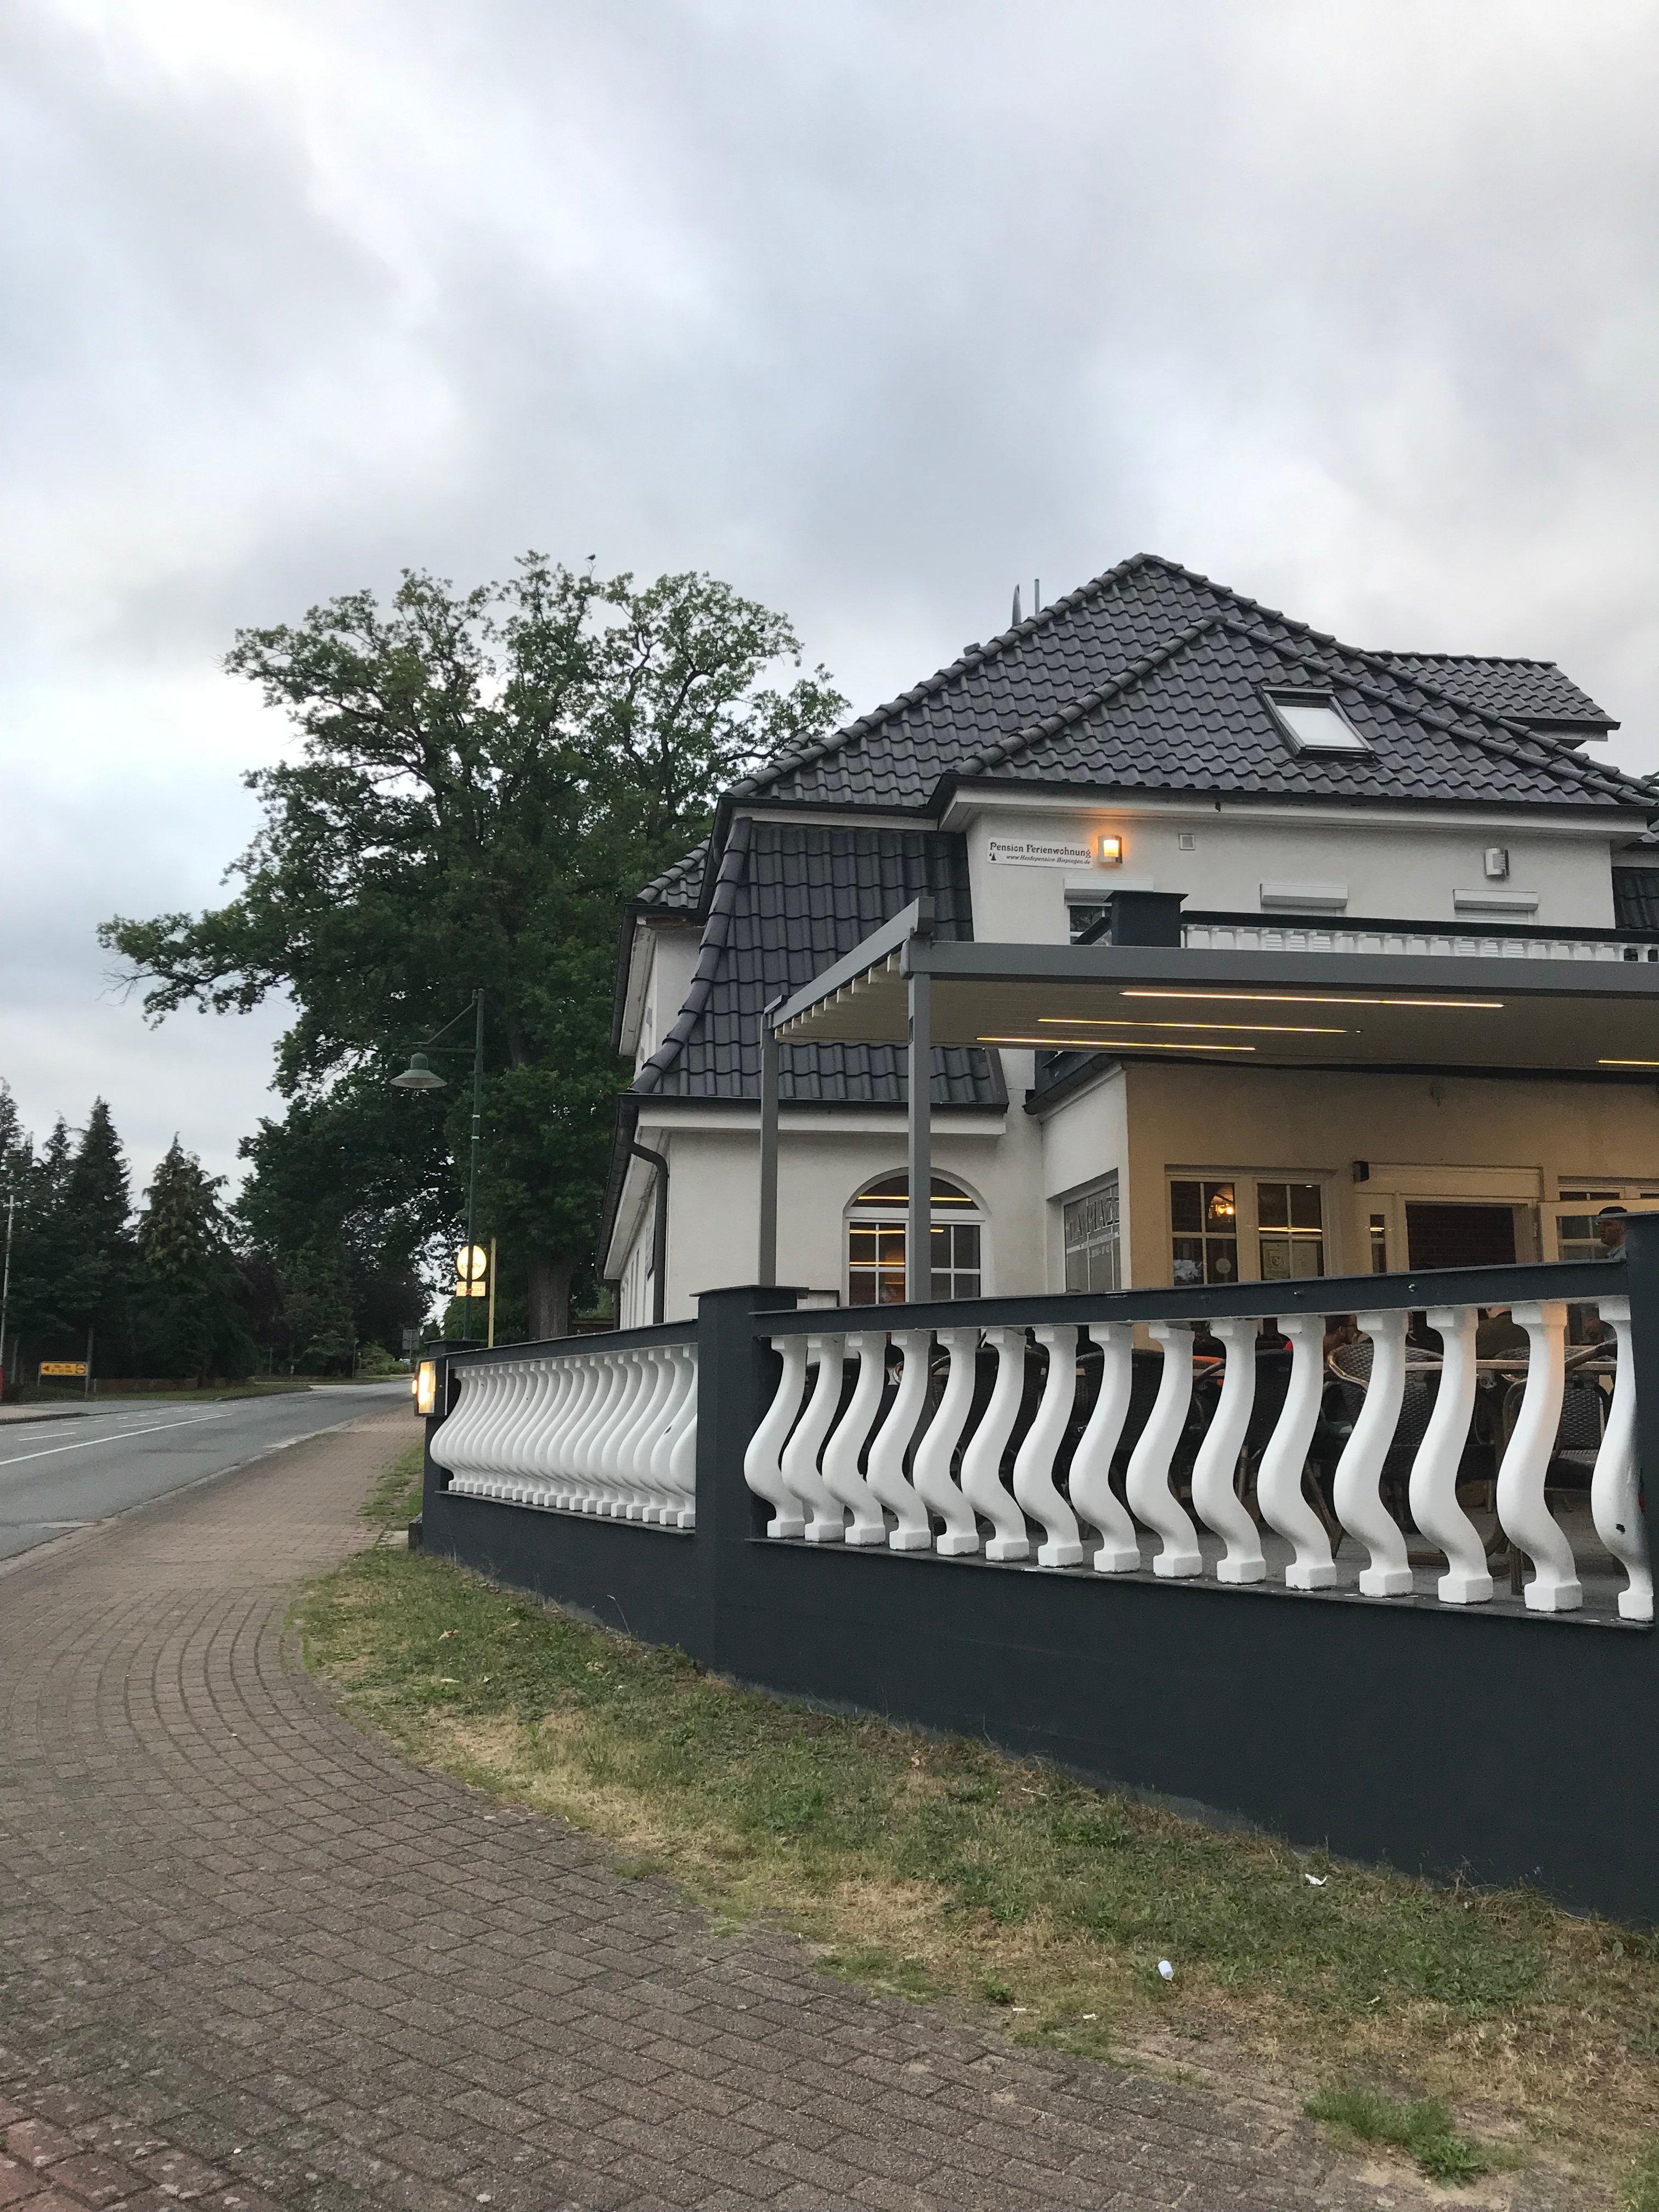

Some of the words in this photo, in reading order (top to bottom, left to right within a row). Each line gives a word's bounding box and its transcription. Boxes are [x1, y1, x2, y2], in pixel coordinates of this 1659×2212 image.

[990, 842, 1023, 852] Pension
[1026, 844, 1091, 858] Ferienwohnung
[1069, 1213, 1084, 1243] LA
